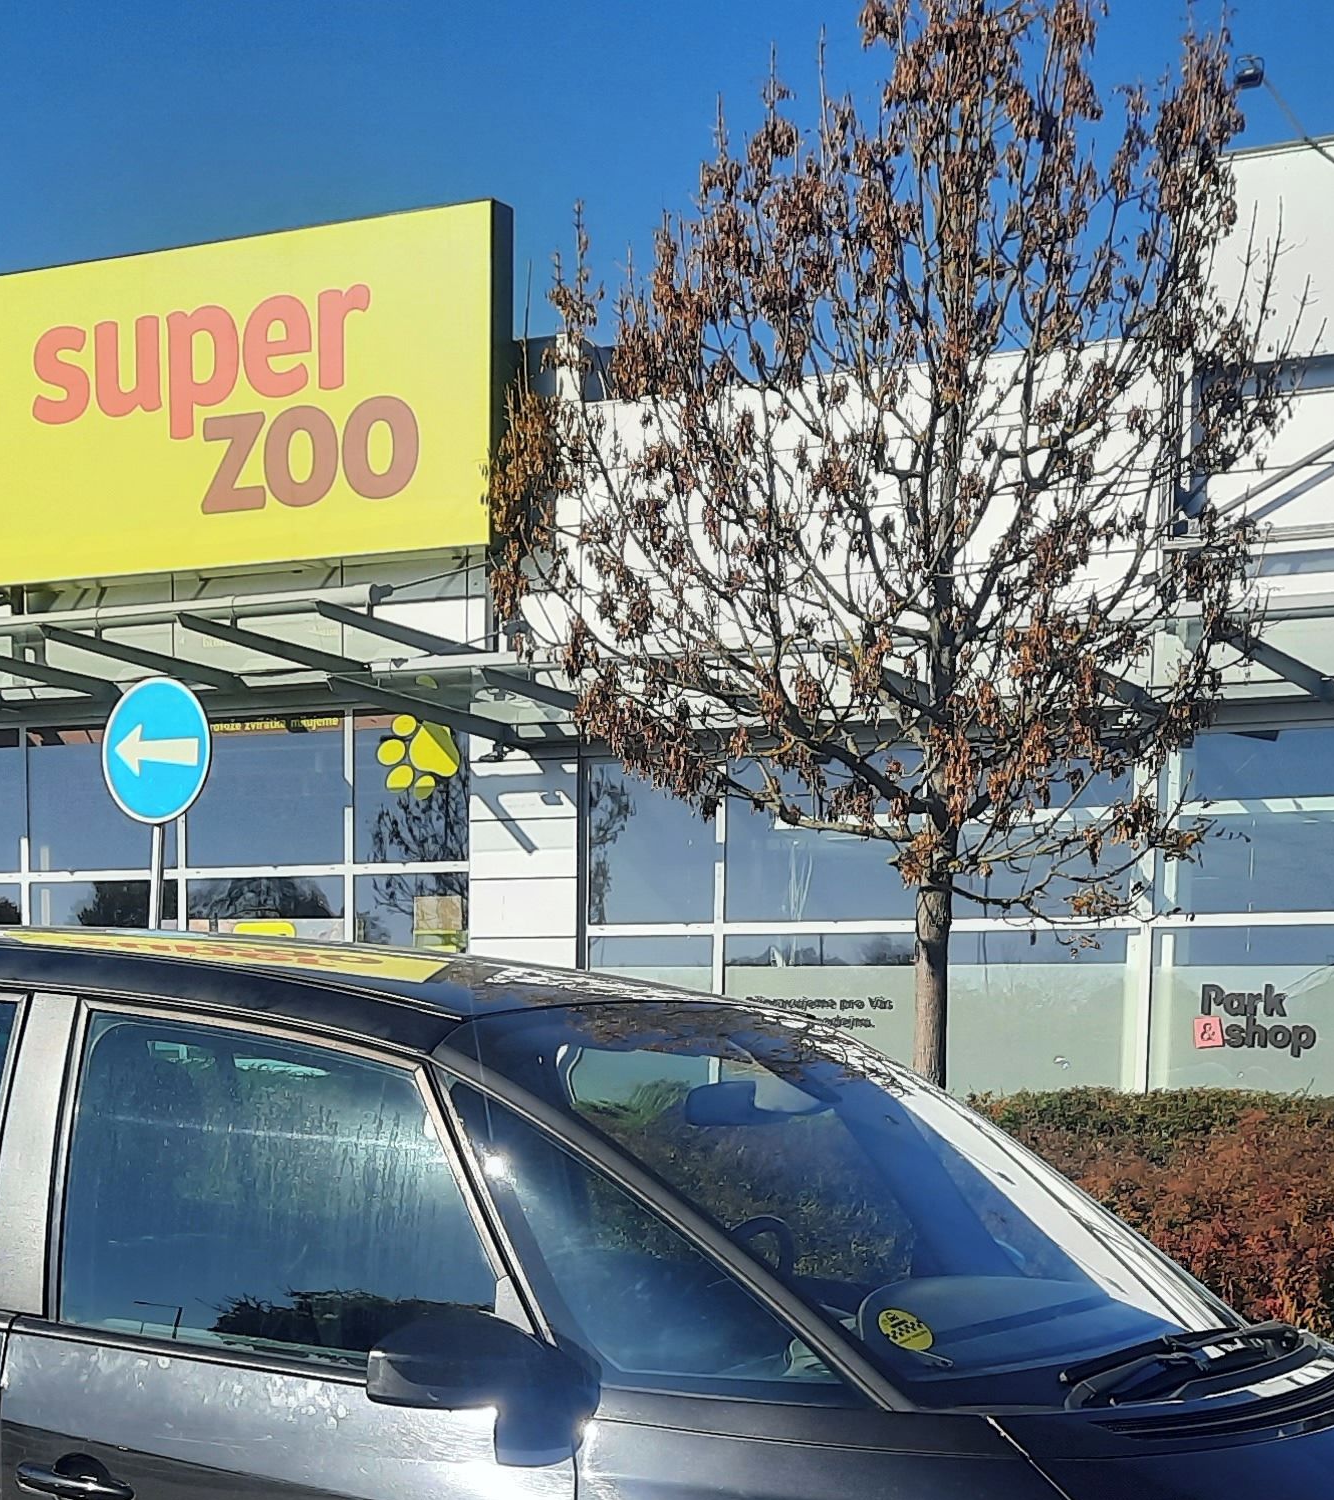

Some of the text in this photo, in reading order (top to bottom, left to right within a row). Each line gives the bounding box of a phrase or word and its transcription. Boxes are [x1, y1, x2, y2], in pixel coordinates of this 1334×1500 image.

[31, 283, 371, 440] super
[201, 395, 419, 514] zoo
[839, 999, 865, 1011] pro
[1200, 983, 1289, 1017] Park
